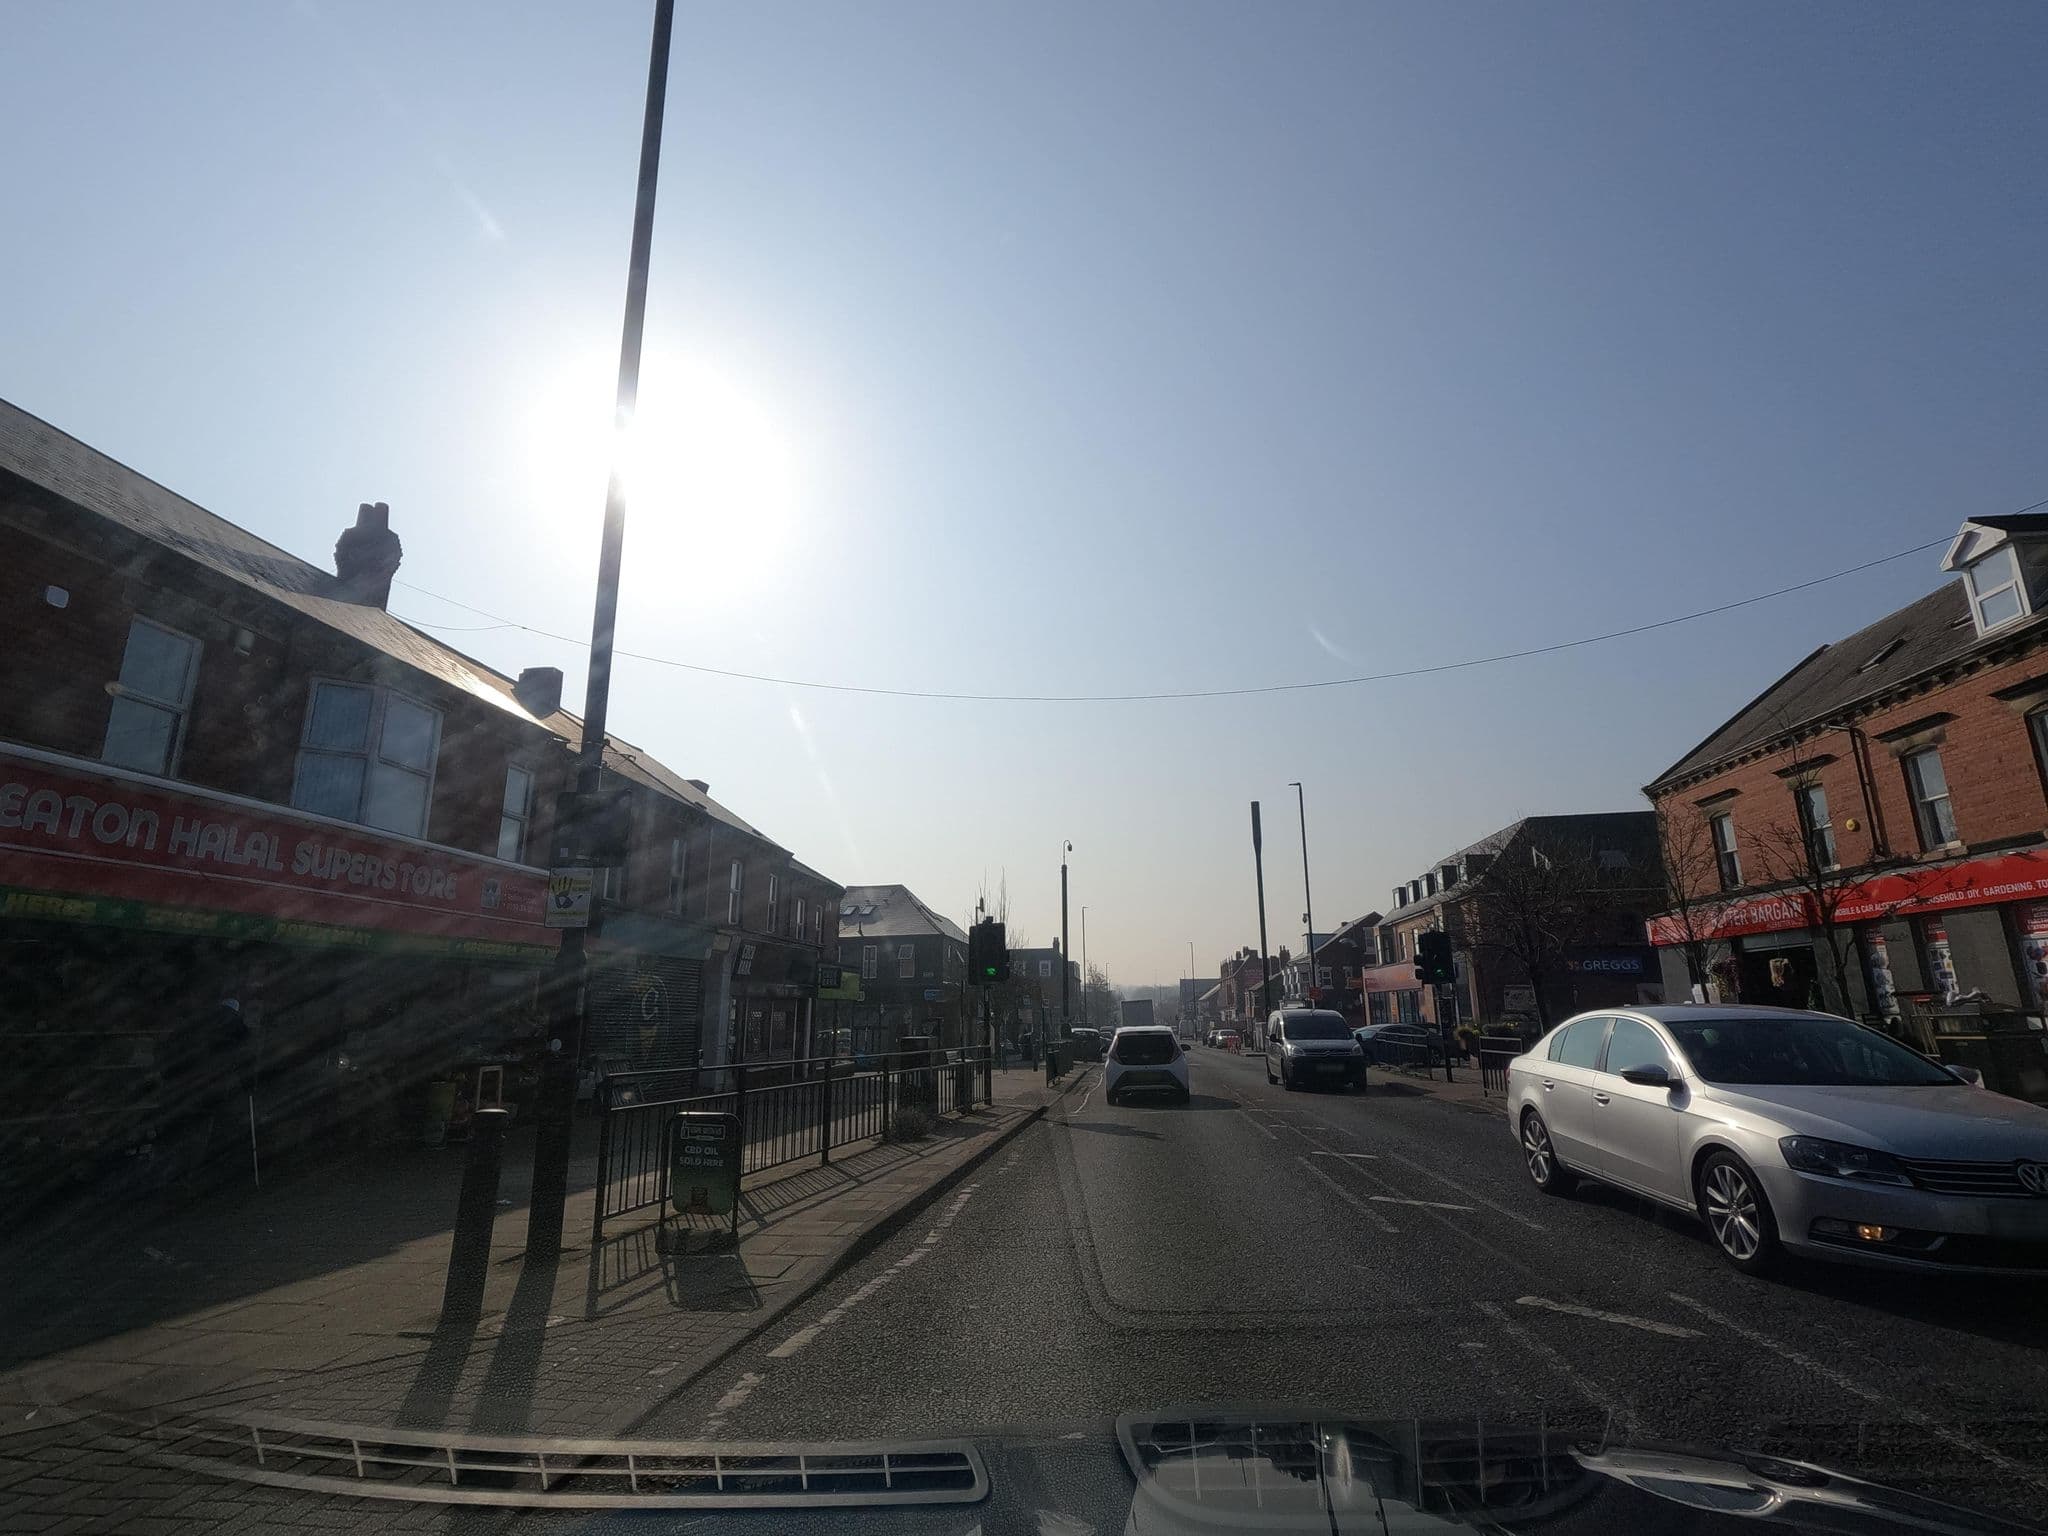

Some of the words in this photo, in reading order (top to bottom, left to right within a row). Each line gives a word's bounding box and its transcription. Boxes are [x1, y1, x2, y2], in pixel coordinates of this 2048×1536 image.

[168, 815, 284, 871] HALAL
[291, 840, 458, 901] SUPERSTORE
[1861, 904, 1874, 913] CAR
[1583, 959, 1640, 971] GREGGS
[704, 1146, 719, 1156] OIL
